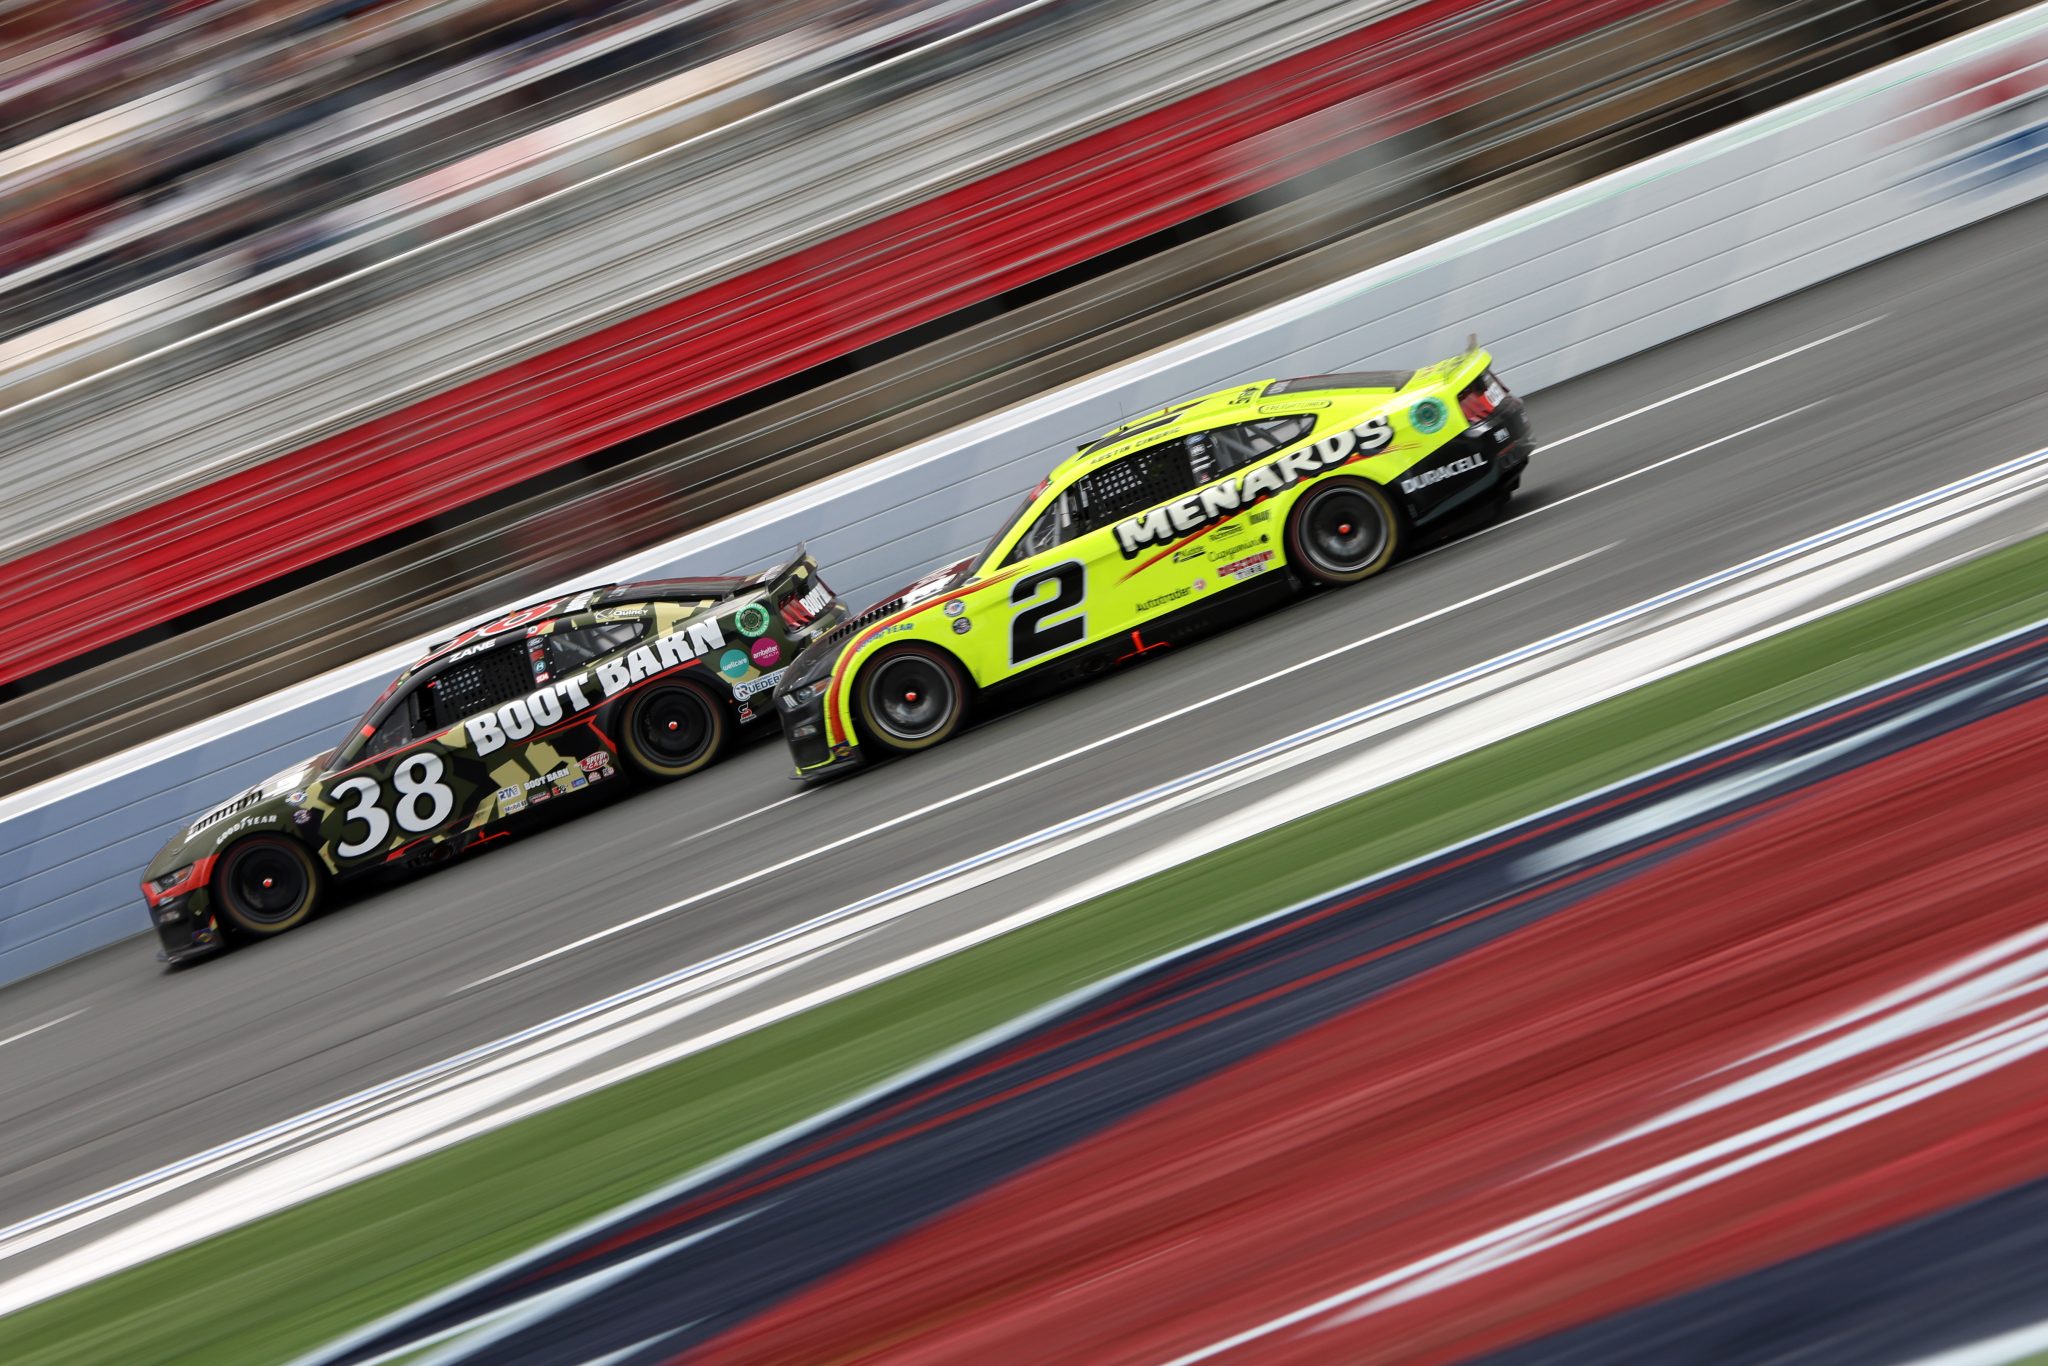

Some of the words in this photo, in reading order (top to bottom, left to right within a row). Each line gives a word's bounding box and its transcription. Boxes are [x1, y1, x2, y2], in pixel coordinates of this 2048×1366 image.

[1113, 414, 1396, 559] MENARDS
[1401, 453, 1488, 494] DURACELL
[1009, 558, 1087, 669] 2
[449, 639, 497, 664] ZANE
[722, 657, 748, 672] wellcare
[753, 644, 778, 660] ambetter
[465, 672, 590, 757] BOOT
[596, 615, 726, 697] BARN
[523, 777, 546, 791] BOOT
[547, 767, 570, 782] BARN
[330, 752, 453, 858] 38
[216, 815, 278, 845] GOODYEAR
